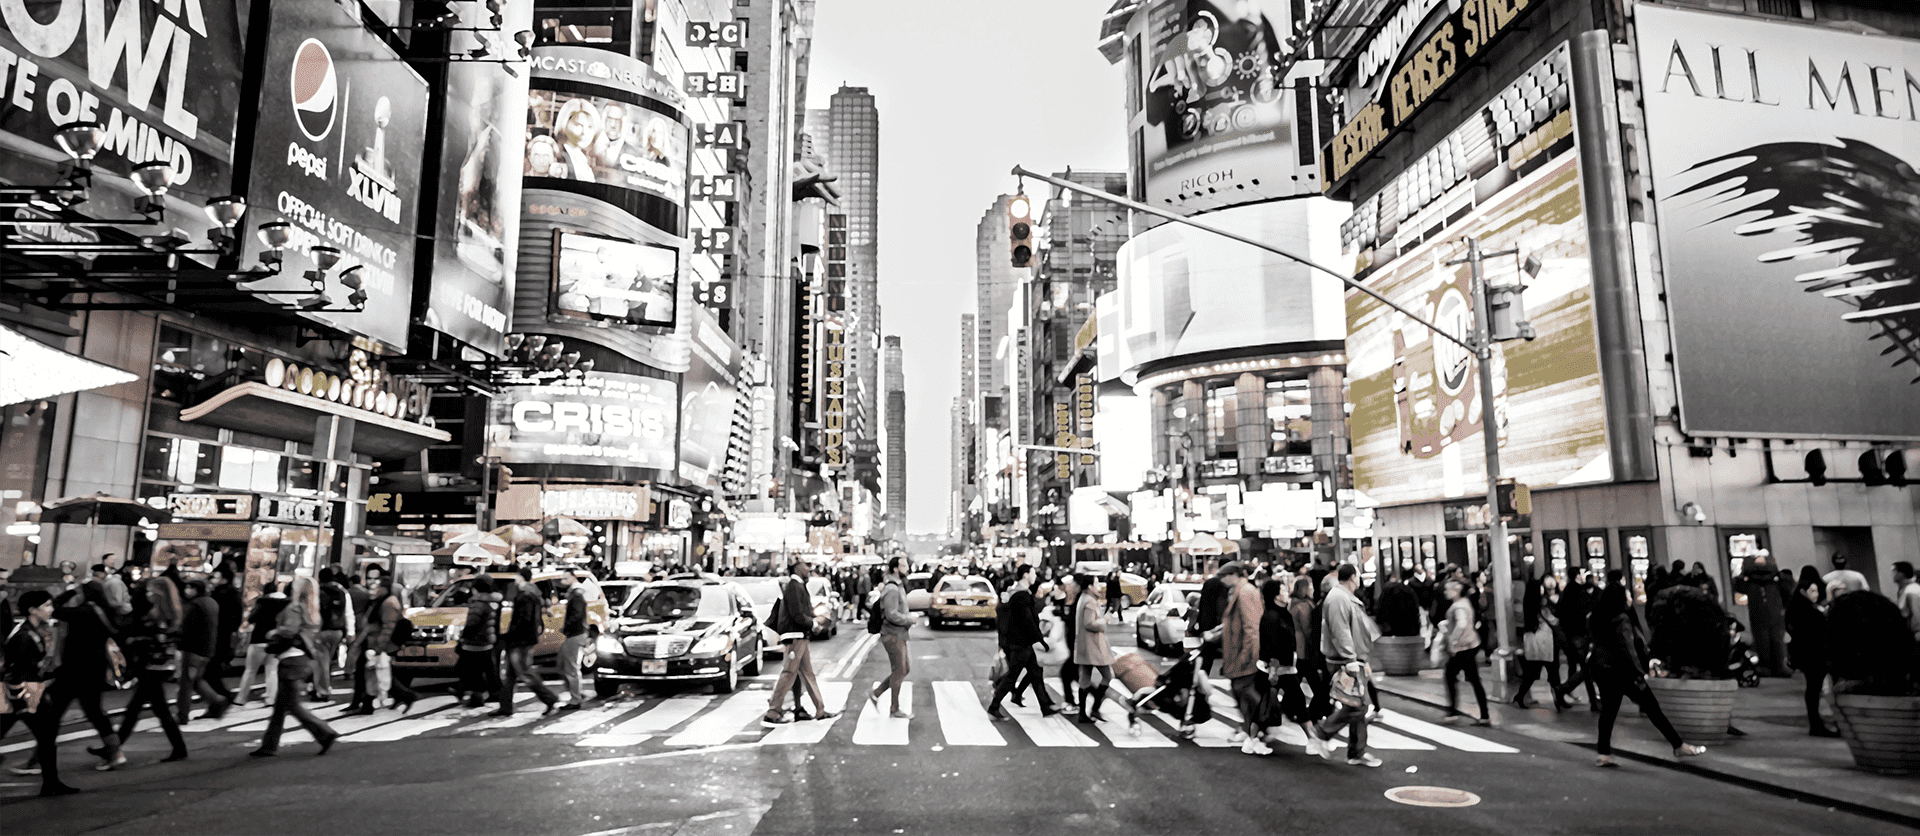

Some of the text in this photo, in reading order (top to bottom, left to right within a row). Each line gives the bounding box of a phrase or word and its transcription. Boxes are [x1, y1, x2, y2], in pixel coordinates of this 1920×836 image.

[1655, 38, 1780, 106] ALL
[104, 107, 193, 186] MIND
[287, 142, 328, 181] pepsi
[1332, 102, 1389, 182] RESERVE
[346, 166, 402, 224] XLVIII
[1180, 168, 1235, 194] RICOH
[277, 190, 327, 236] OFFICIAL
[327, 217, 355, 248] SOFT
[353, 232, 384, 264] DRINK
[382, 247, 397, 270] OF
[463, 293, 483, 322] FOR
[512, 400, 665, 440] CRISIS
[827, 328, 844, 466] TUSSAUDS
